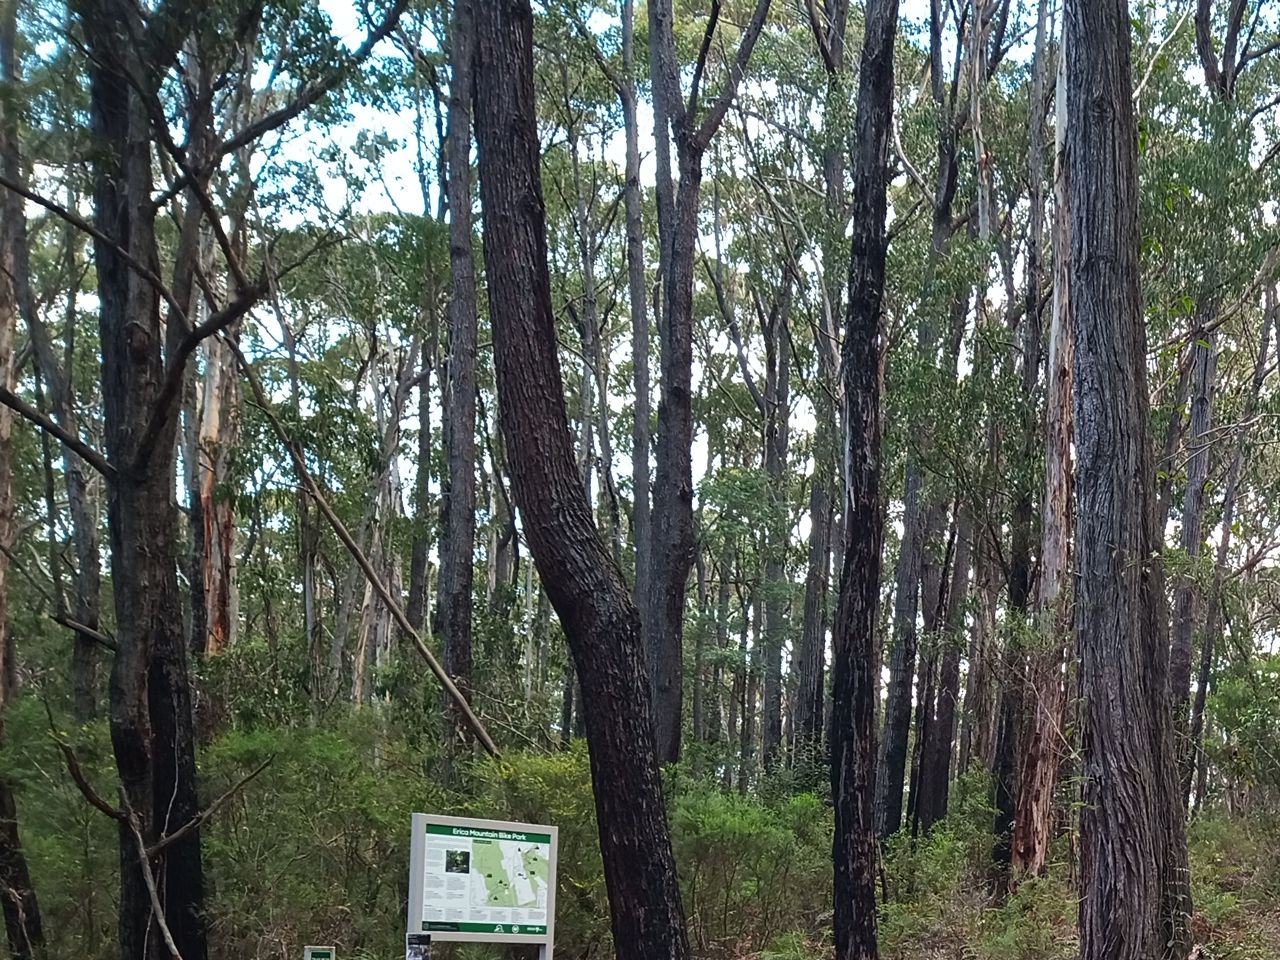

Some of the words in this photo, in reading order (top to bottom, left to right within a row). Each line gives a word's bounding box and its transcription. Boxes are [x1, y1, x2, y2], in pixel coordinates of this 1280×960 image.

[452, 828, 469, 836] Erica
[469, 829, 498, 838] Mountain
[512, 833, 526, 841] Park
